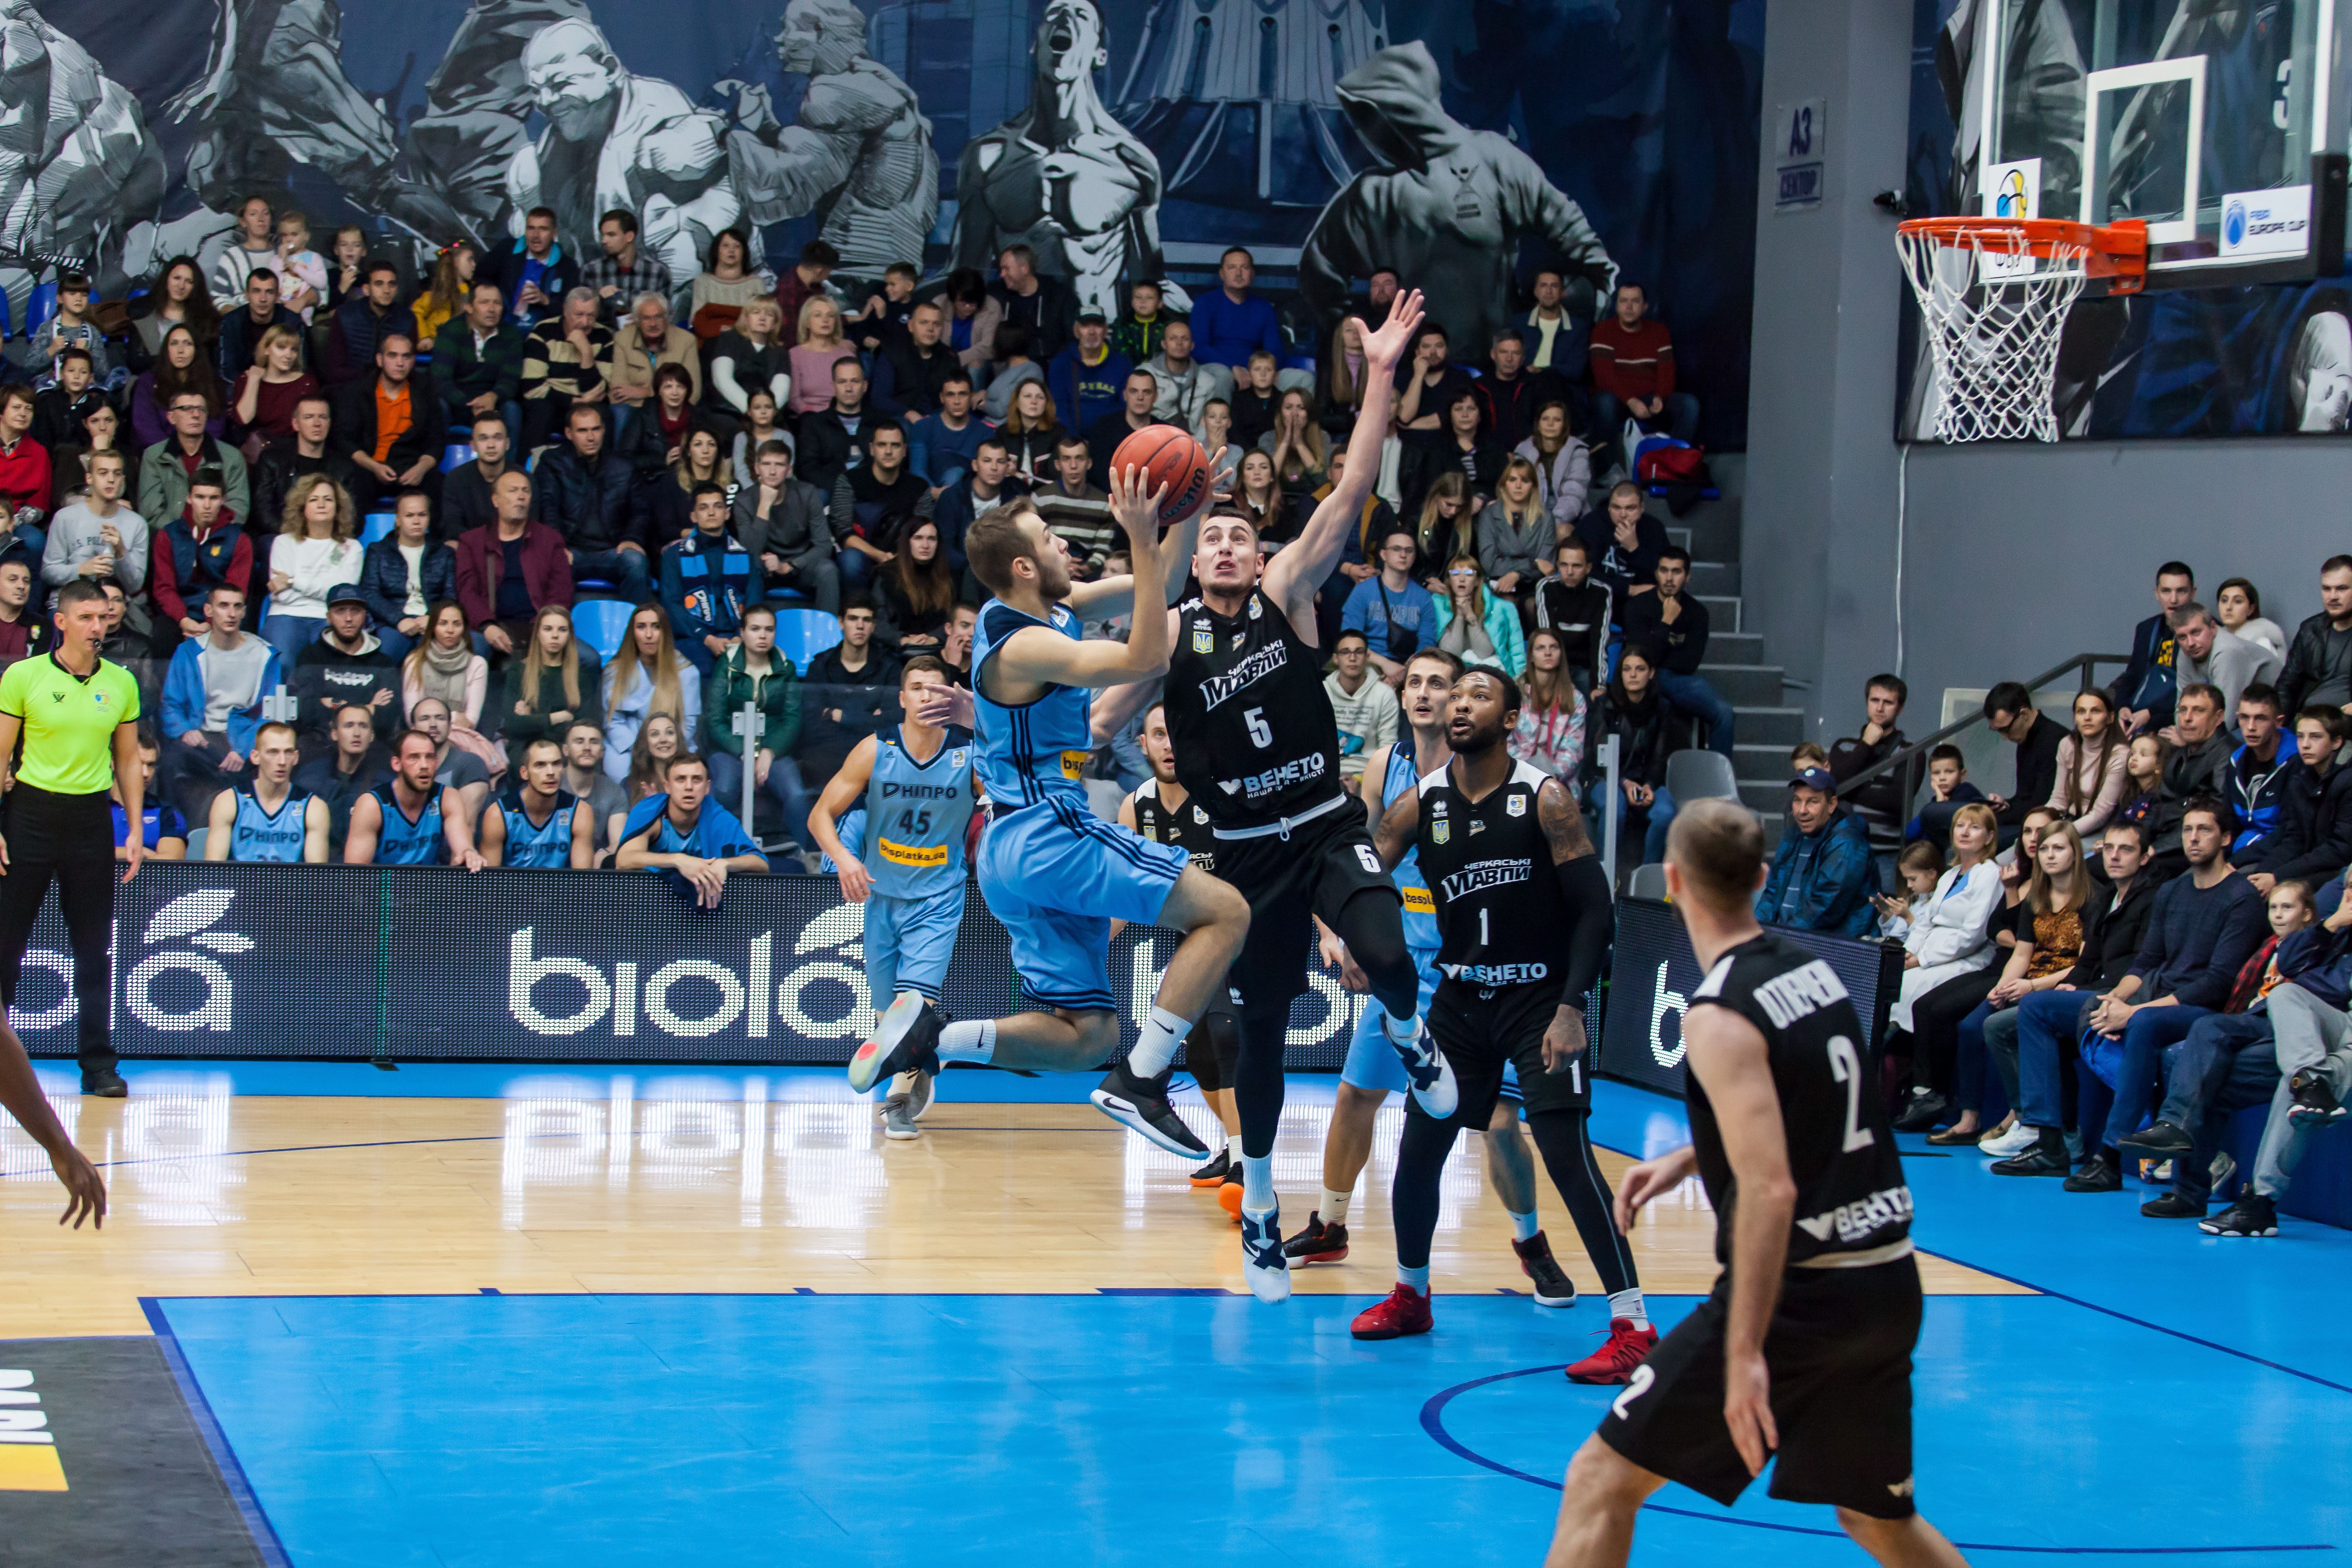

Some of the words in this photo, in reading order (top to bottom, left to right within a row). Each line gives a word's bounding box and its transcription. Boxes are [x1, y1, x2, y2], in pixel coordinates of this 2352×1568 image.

[1243, 707, 1273, 748] 5
[1243, 752, 1324, 793] ВЕНЕТО
[899, 809, 931, 835] 45
[1479, 908, 1489, 945] 1
[1460, 963, 1547, 982] ВЕНЕТО
[1568, 1060, 1582, 1093] 1
[1826, 1034, 1875, 1153] 2
[1613, 1364, 1655, 1421] 2
